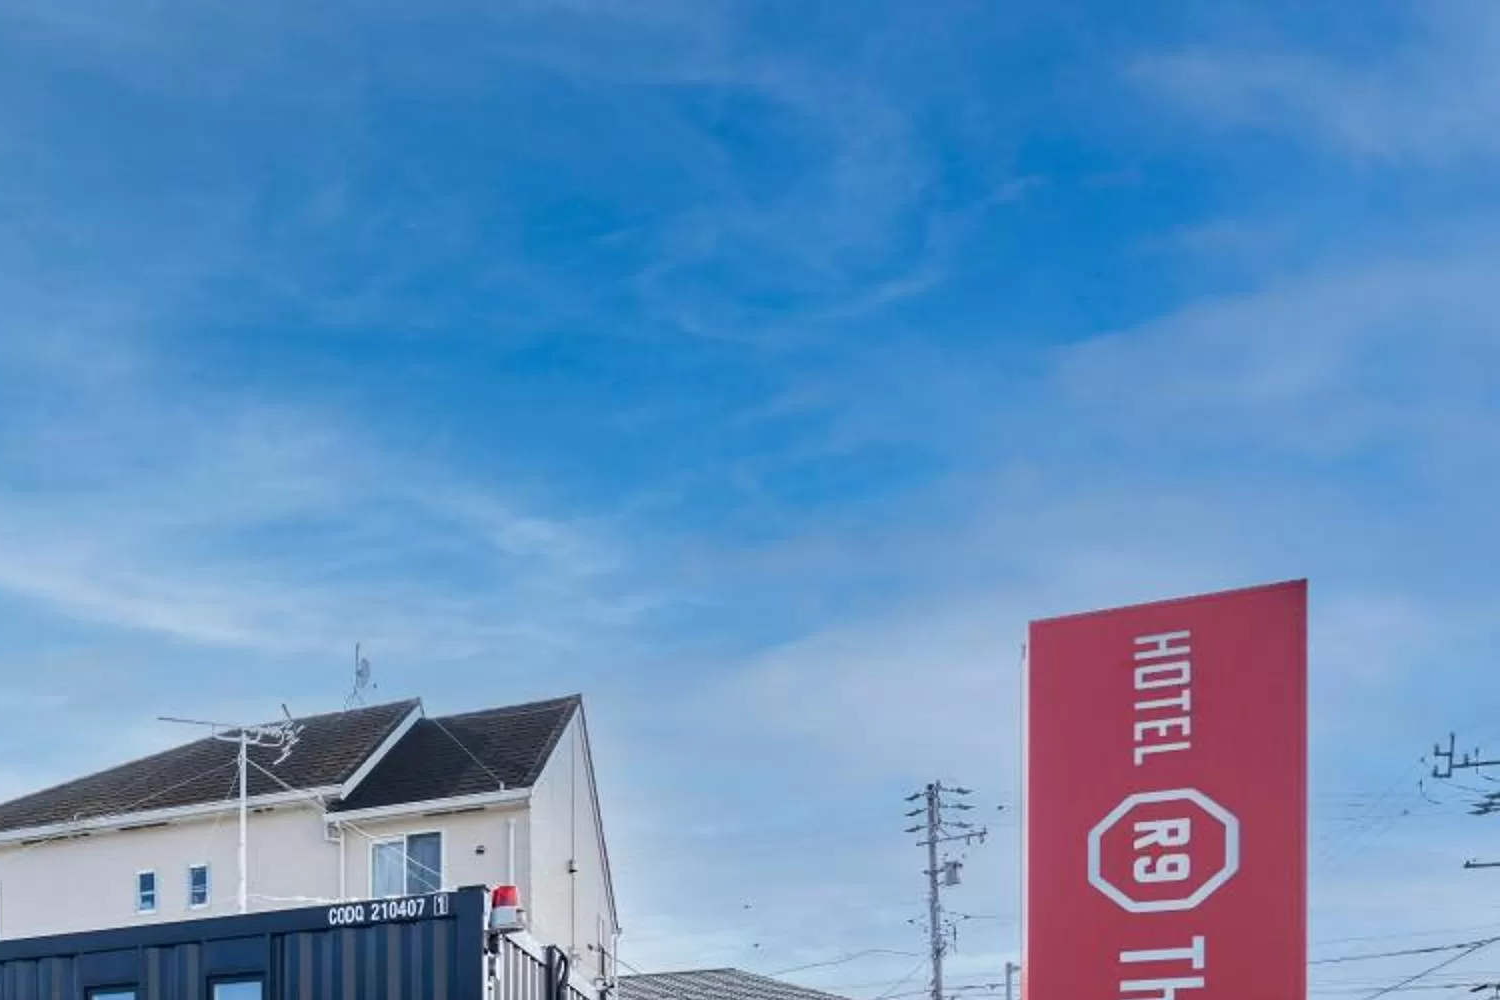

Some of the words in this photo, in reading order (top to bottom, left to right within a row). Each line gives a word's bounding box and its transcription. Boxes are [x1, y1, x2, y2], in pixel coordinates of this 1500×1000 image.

[1134, 630, 1191, 766] HOTEL
[1133, 816, 1191, 884] R9
[371, 897, 425, 921] 210407
